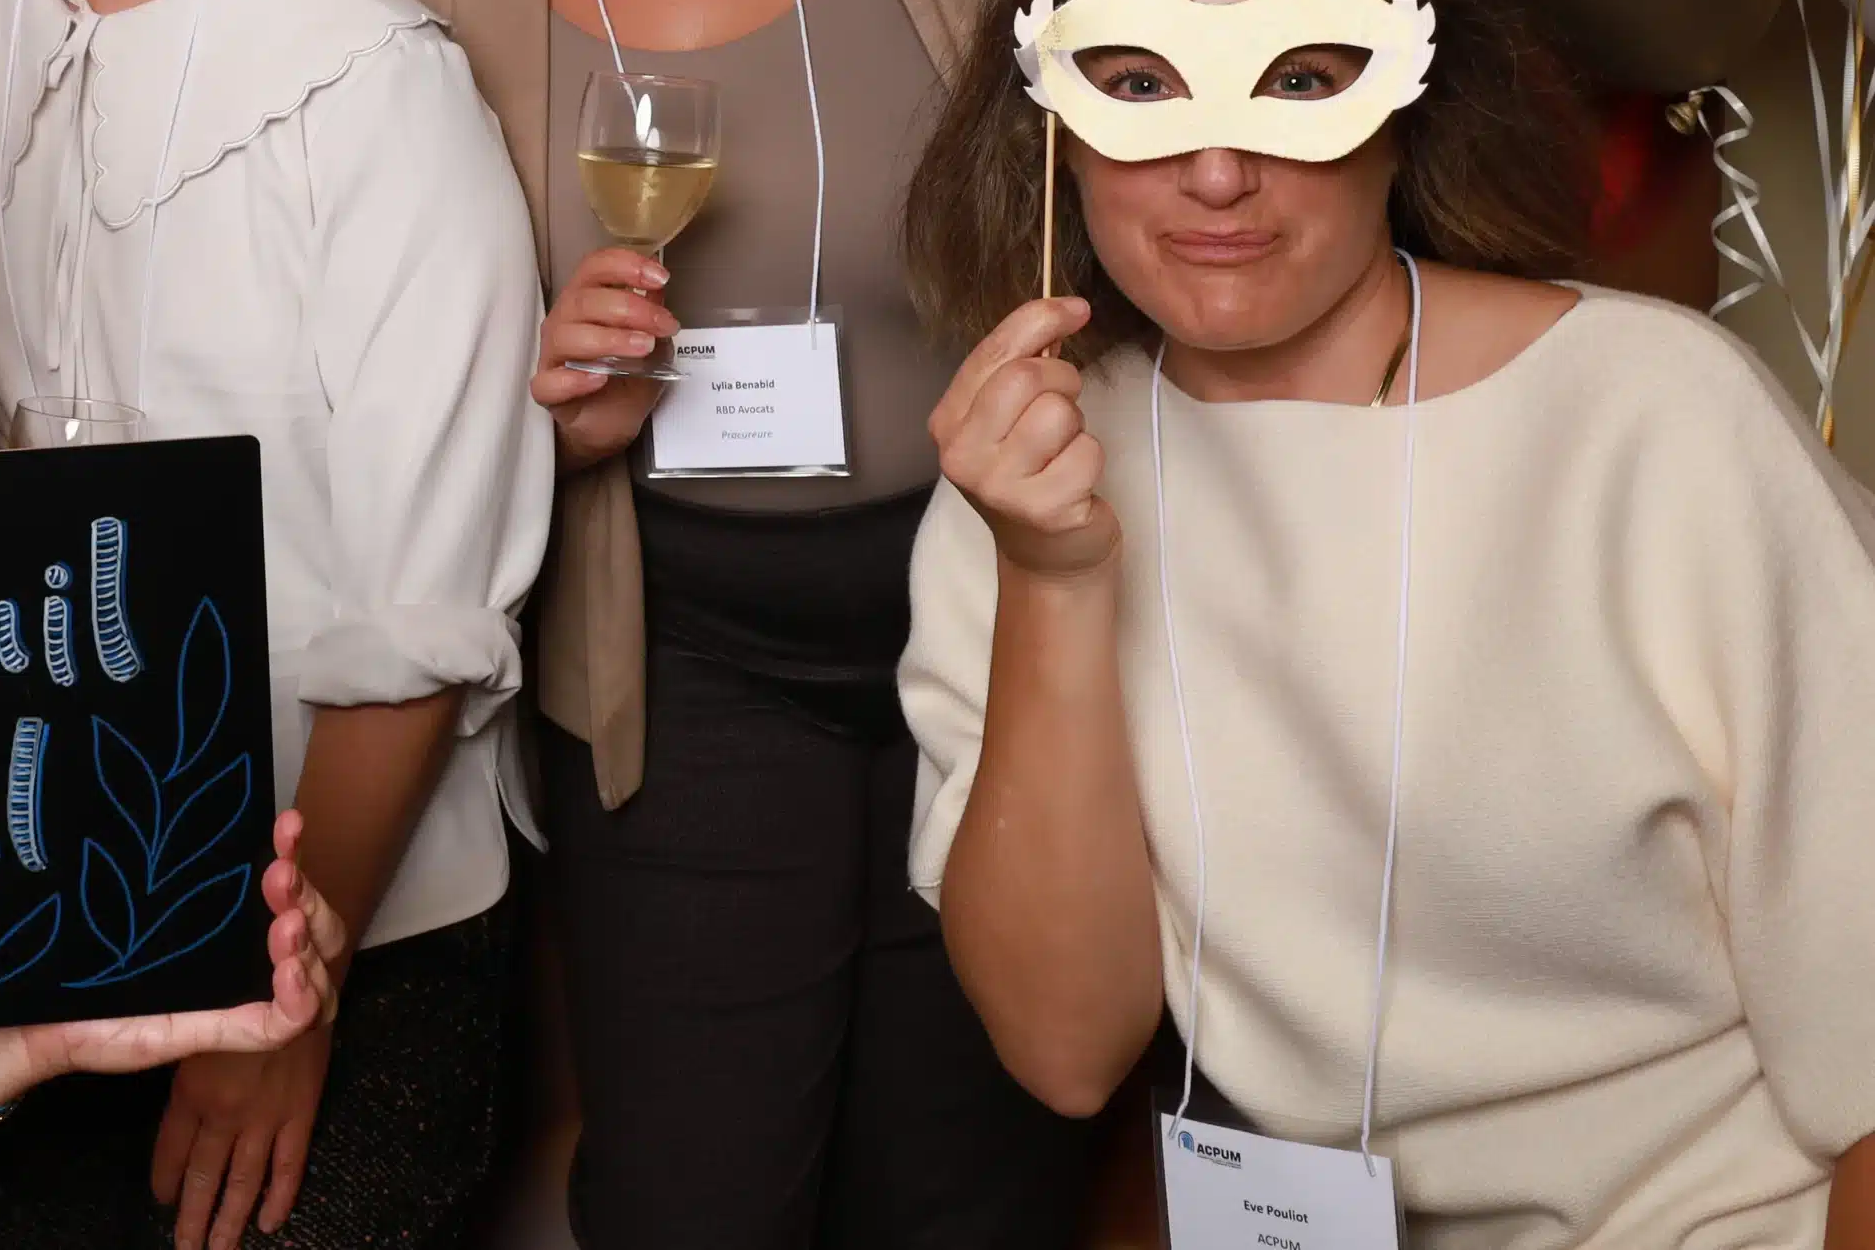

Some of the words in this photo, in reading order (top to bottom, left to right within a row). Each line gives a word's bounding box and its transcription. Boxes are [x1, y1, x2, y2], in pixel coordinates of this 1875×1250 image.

[676, 345, 715, 354] ACPUM
[711, 381, 733, 391] Lylia
[735, 379, 775, 390] Benabid
[715, 405, 736, 415] RBD
[738, 404, 775, 414] Avocats
[1196, 1143, 1241, 1162] ACPUM
[1243, 1200, 1264, 1214] Eve
[1266, 1205, 1309, 1223] Pouliot
[1257, 1233, 1301, 1250] ACPUM
